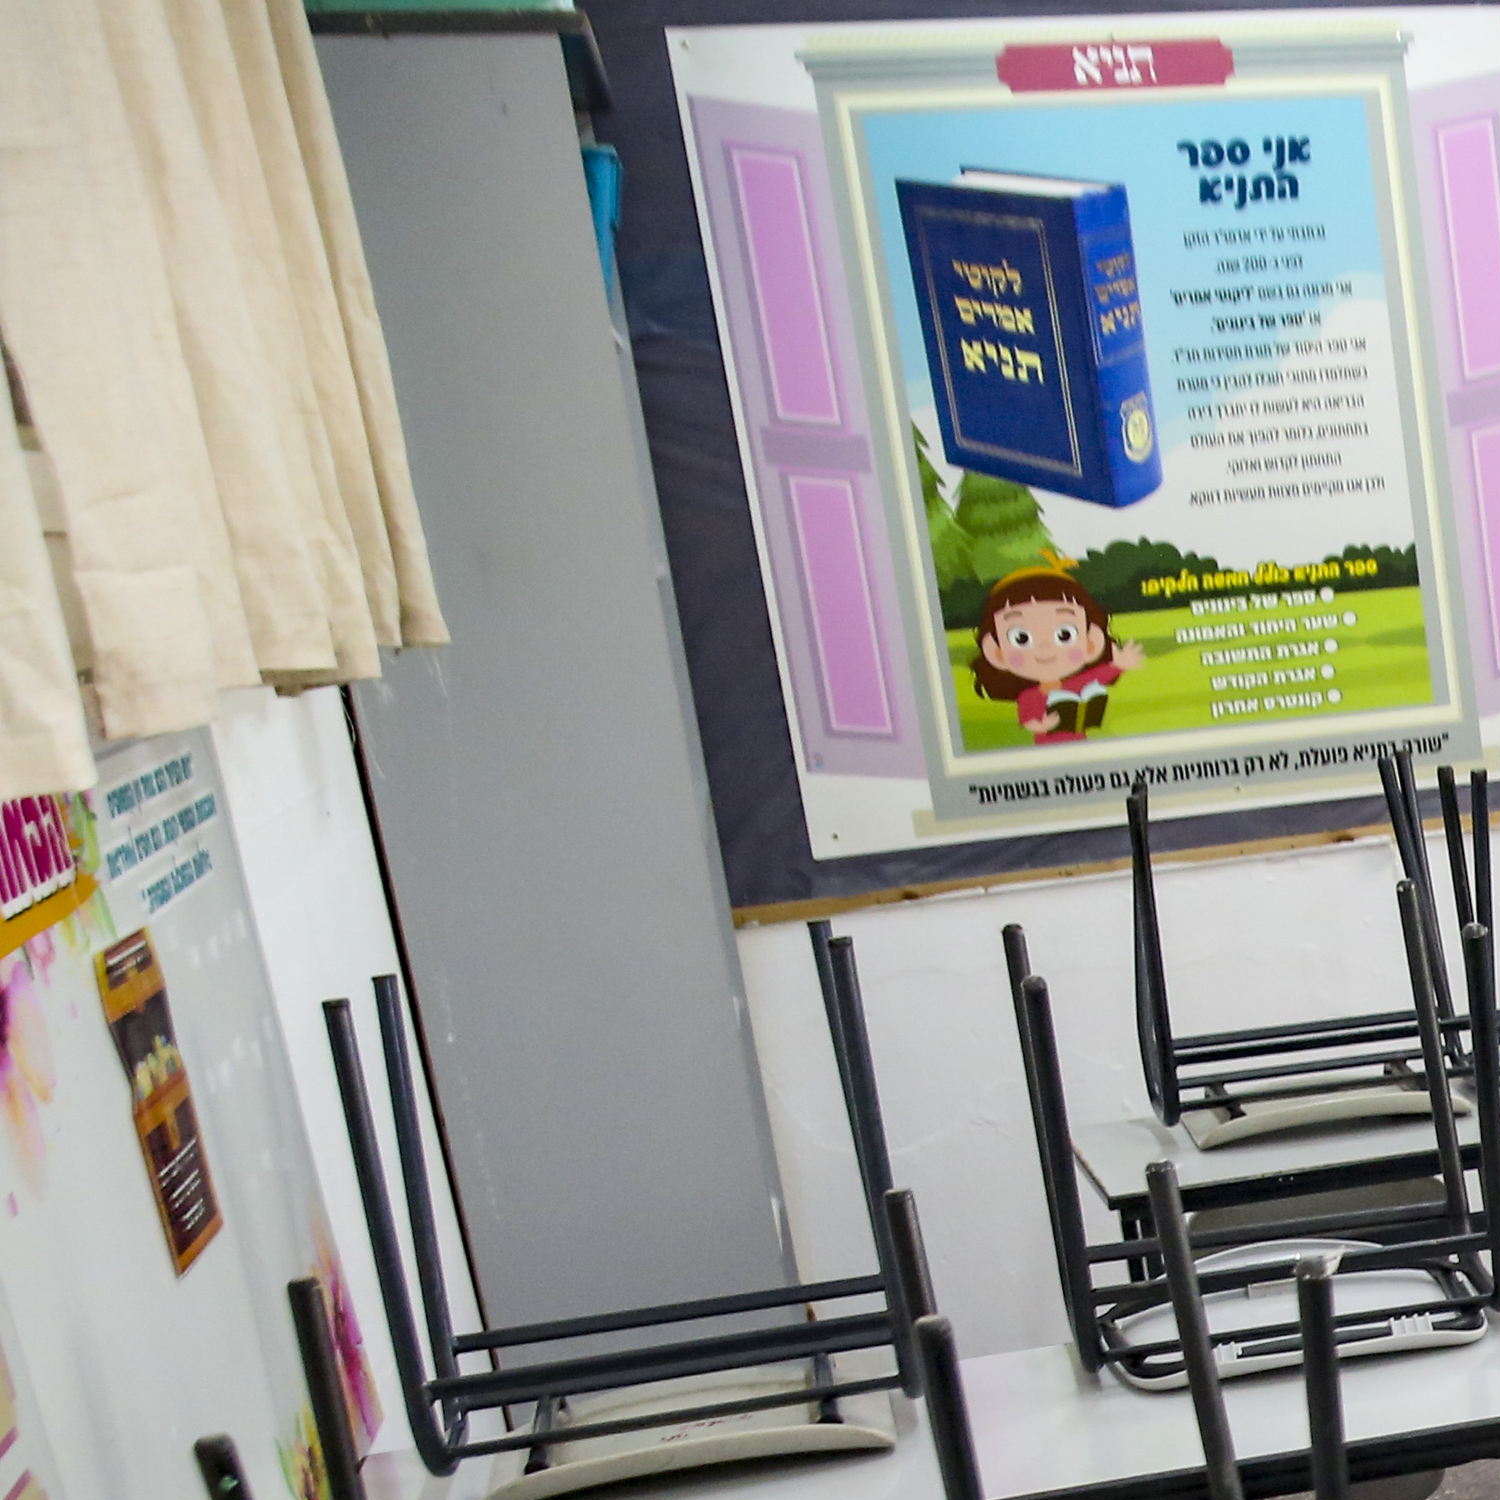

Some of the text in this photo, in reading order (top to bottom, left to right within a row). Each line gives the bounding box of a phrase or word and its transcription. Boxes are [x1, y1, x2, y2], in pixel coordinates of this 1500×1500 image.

[1071, 43, 1157, 88] תניא
[1177, 135, 1311, 172] אני ספר
[1199, 170, 1300, 211] התניא
[952, 258, 1022, 298] לקוטי
[953, 293, 1036, 336] אמרים
[1100, 303, 1141, 336] תניא
[960, 336, 1045, 386] תניא
[1201, 569, 1249, 590] חמשה
[1252, 559, 1290, 585] כולל
[1291, 560, 1335, 584] התניא
[1343, 557, 1378, 576] ספר
[1189, 588, 1317, 616] ספר של בינונים
[1173, 612, 1340, 643] שער היחוד והאמונה
[1199, 639, 1320, 667] אגרת התשובה
[1210, 665, 1317, 693] אגרת הקודש
[1209, 690, 1324, 719] קונטרס אחרון
[1267, 749, 1289, 770] לא
[1292, 744, 1348, 770] פועלת,
[1351, 739, 1394, 761] בתניא
[1108, 768, 1130, 788] גם
[1132, 762, 1168, 786] אלא
[1170, 756, 1239, 781] ברוחניות
[1242, 753, 1265, 776] רק
[968, 777, 1050, 804] בגשמיות"
[1053, 769, 1106, 794] פעולה
